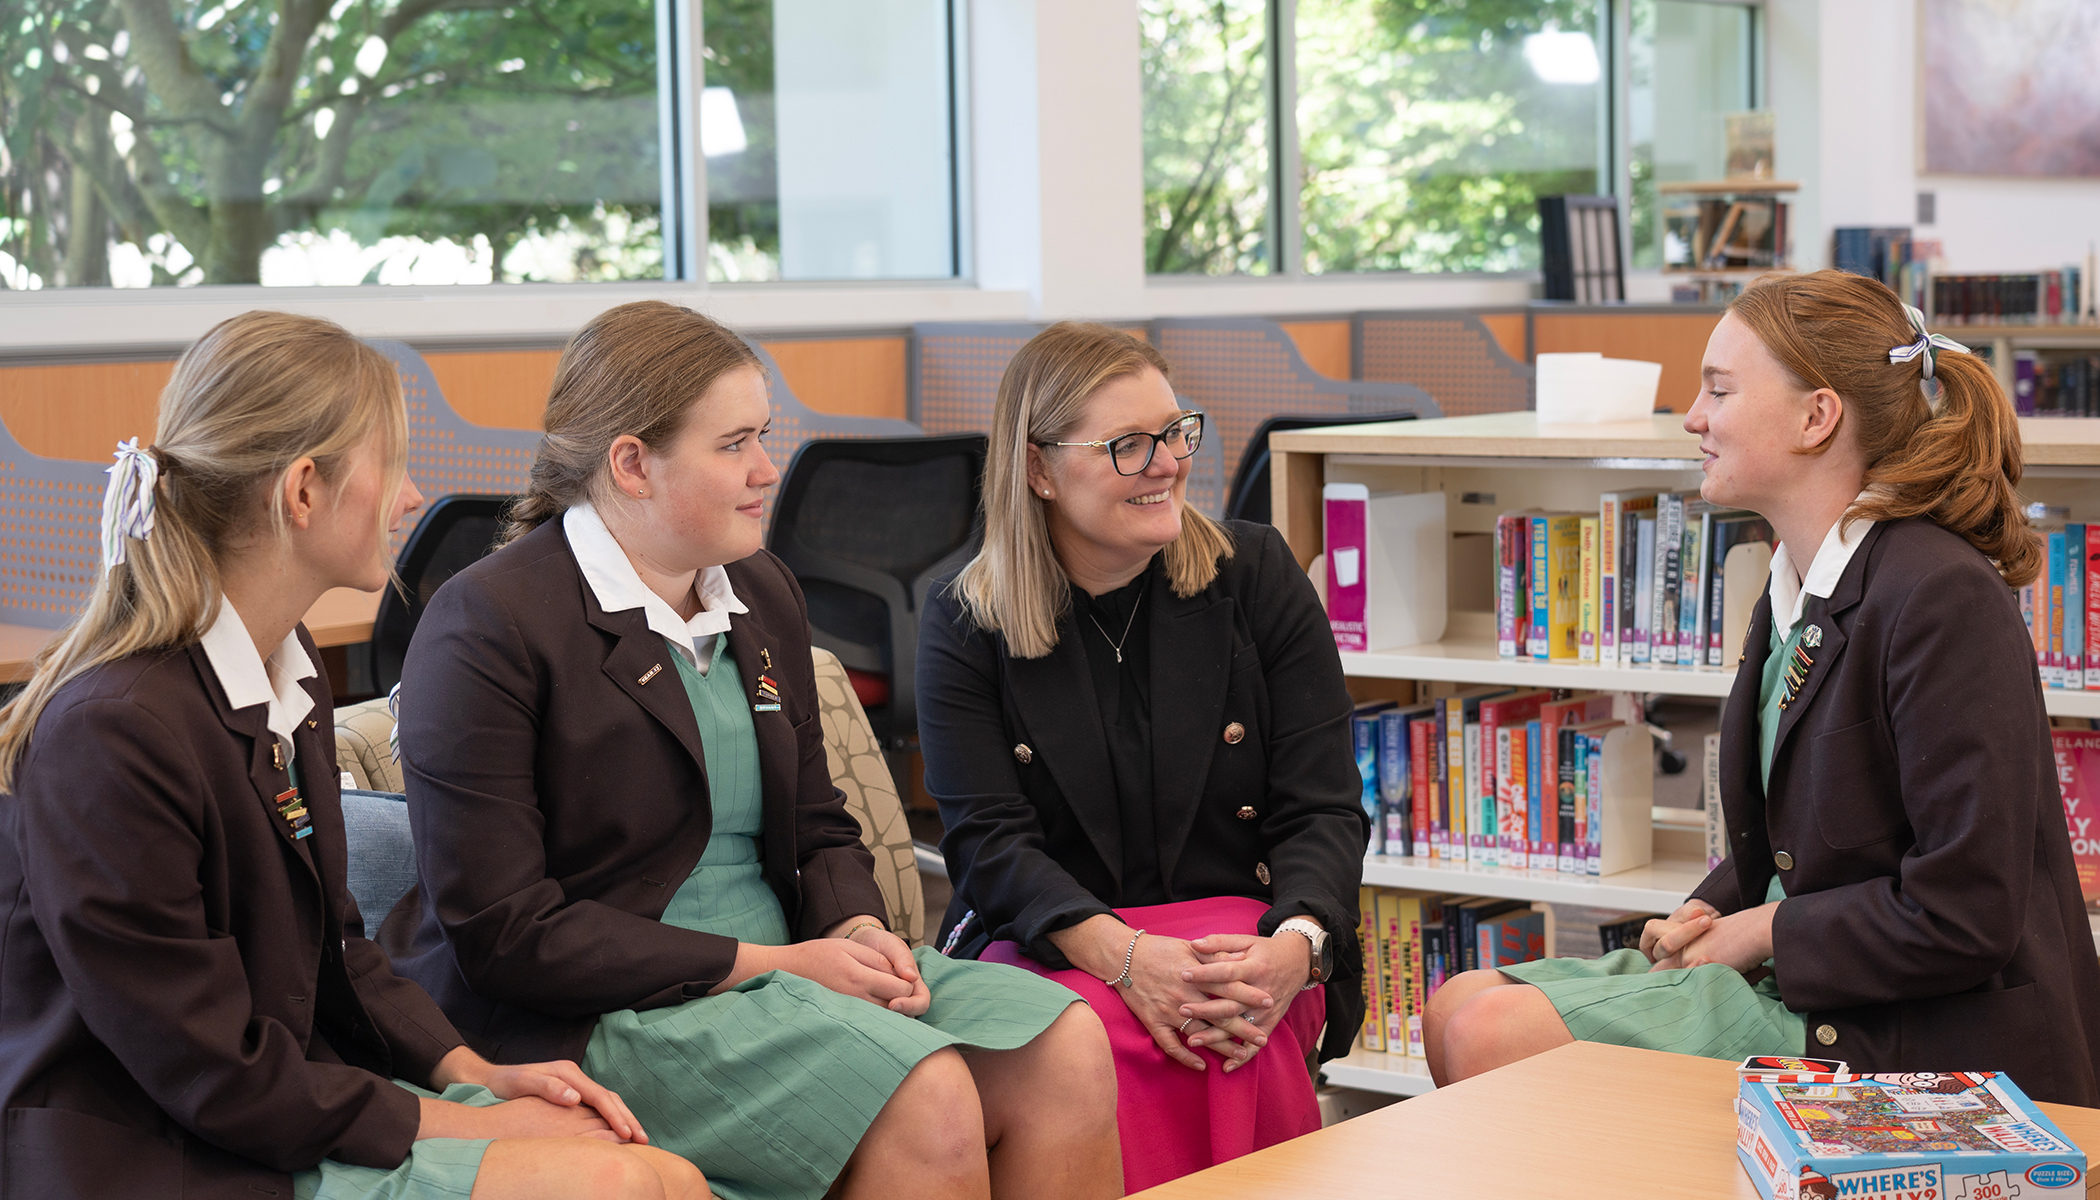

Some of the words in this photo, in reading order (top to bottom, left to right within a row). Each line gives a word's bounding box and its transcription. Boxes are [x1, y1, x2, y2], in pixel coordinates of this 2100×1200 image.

[1534, 523, 1545, 541] YES
[1668, 502, 1679, 543] FUTURE
[1534, 543, 1545, 558] NO
[1581, 526, 1593, 552] Dolly
[1534, 559, 1546, 593] MAYBE
[1584, 557, 1593, 599] Alderton
[1666, 551, 1678, 590] GIRL
[1534, 595, 1546, 609] SO
[1712, 578, 1722, 621] Hasina
[1448, 710, 1462, 734] THE
[1484, 707, 1494, 722] THE
[1449, 735, 1463, 767] DEED
[1484, 725, 1495, 767] VANISHING
[1509, 785, 1527, 812] ONE
[1363, 911, 1373, 939] LOLA
[1388, 917, 1400, 946] LOLA
[1409, 920, 1420, 949] LOLA
[1366, 942, 1375, 953] IN
[1381, 938, 1391, 970] TRENT
[1390, 948, 1400, 960] IN
[1402, 941, 1412, 973] TRENT
[1411, 951, 1421, 963] IN
[1367, 956, 1376, 975] THE
[1391, 963, 1401, 982] THE
[1412, 965, 1422, 985] THE
[1368, 977, 1379, 1020] MIRROR
[1981, 1125, 2039, 1152] WALLY?
[2007, 1121, 2065, 1152] WHERE'S
[1837, 1169, 1937, 1197] WHERE'S
[1973, 1184, 2001, 1200] 300
